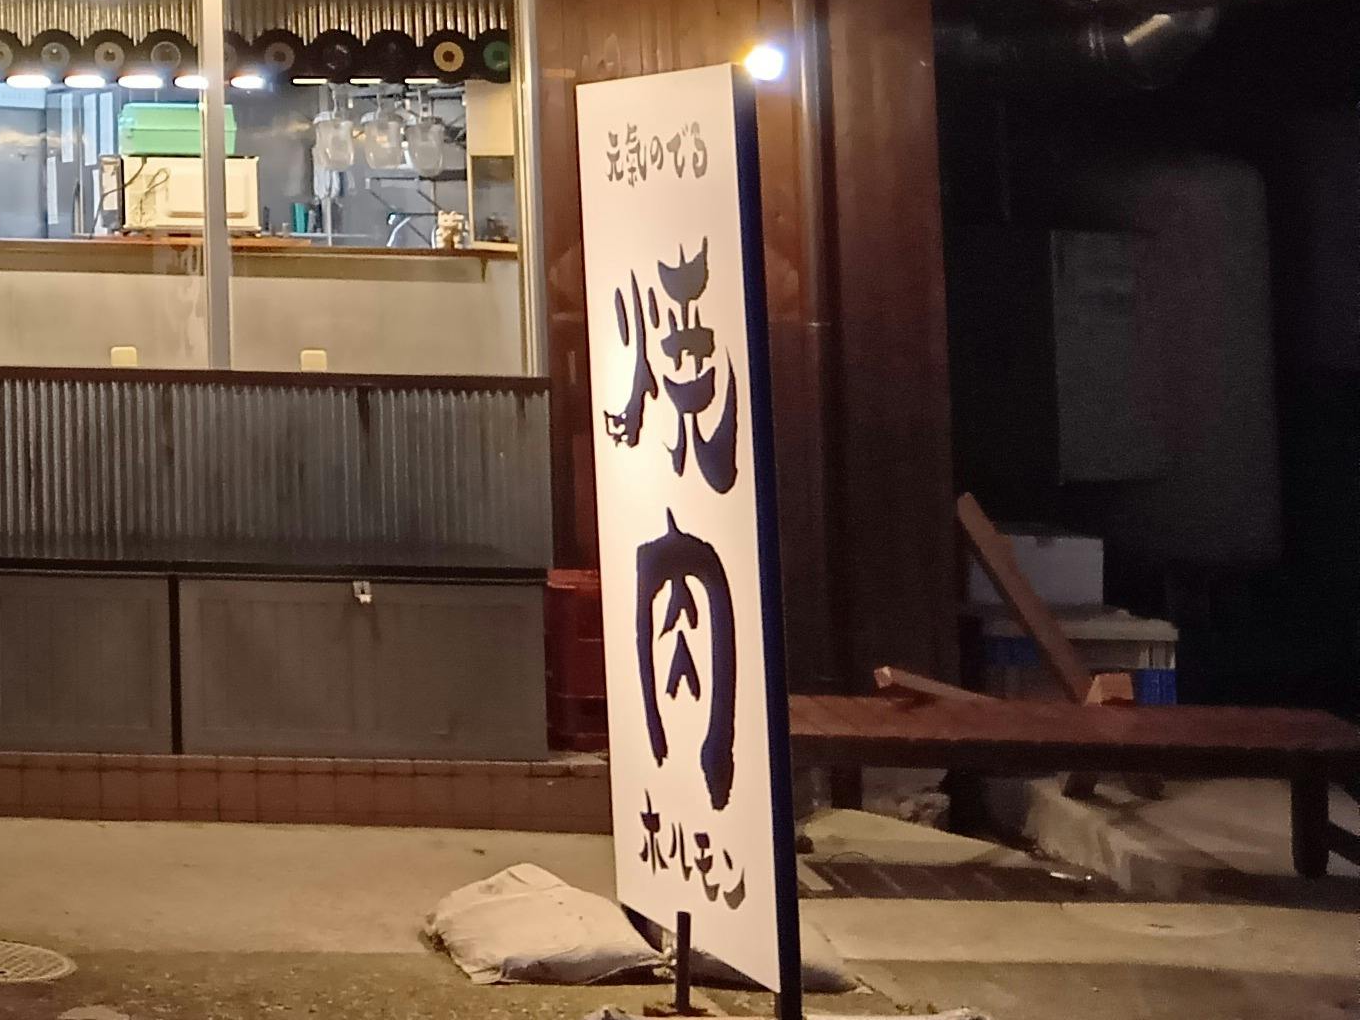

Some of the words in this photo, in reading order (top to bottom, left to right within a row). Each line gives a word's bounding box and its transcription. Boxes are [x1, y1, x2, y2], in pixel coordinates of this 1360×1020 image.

[603, 235, 739, 811] 焼肉
[639, 788, 746, 911] ホルモン
